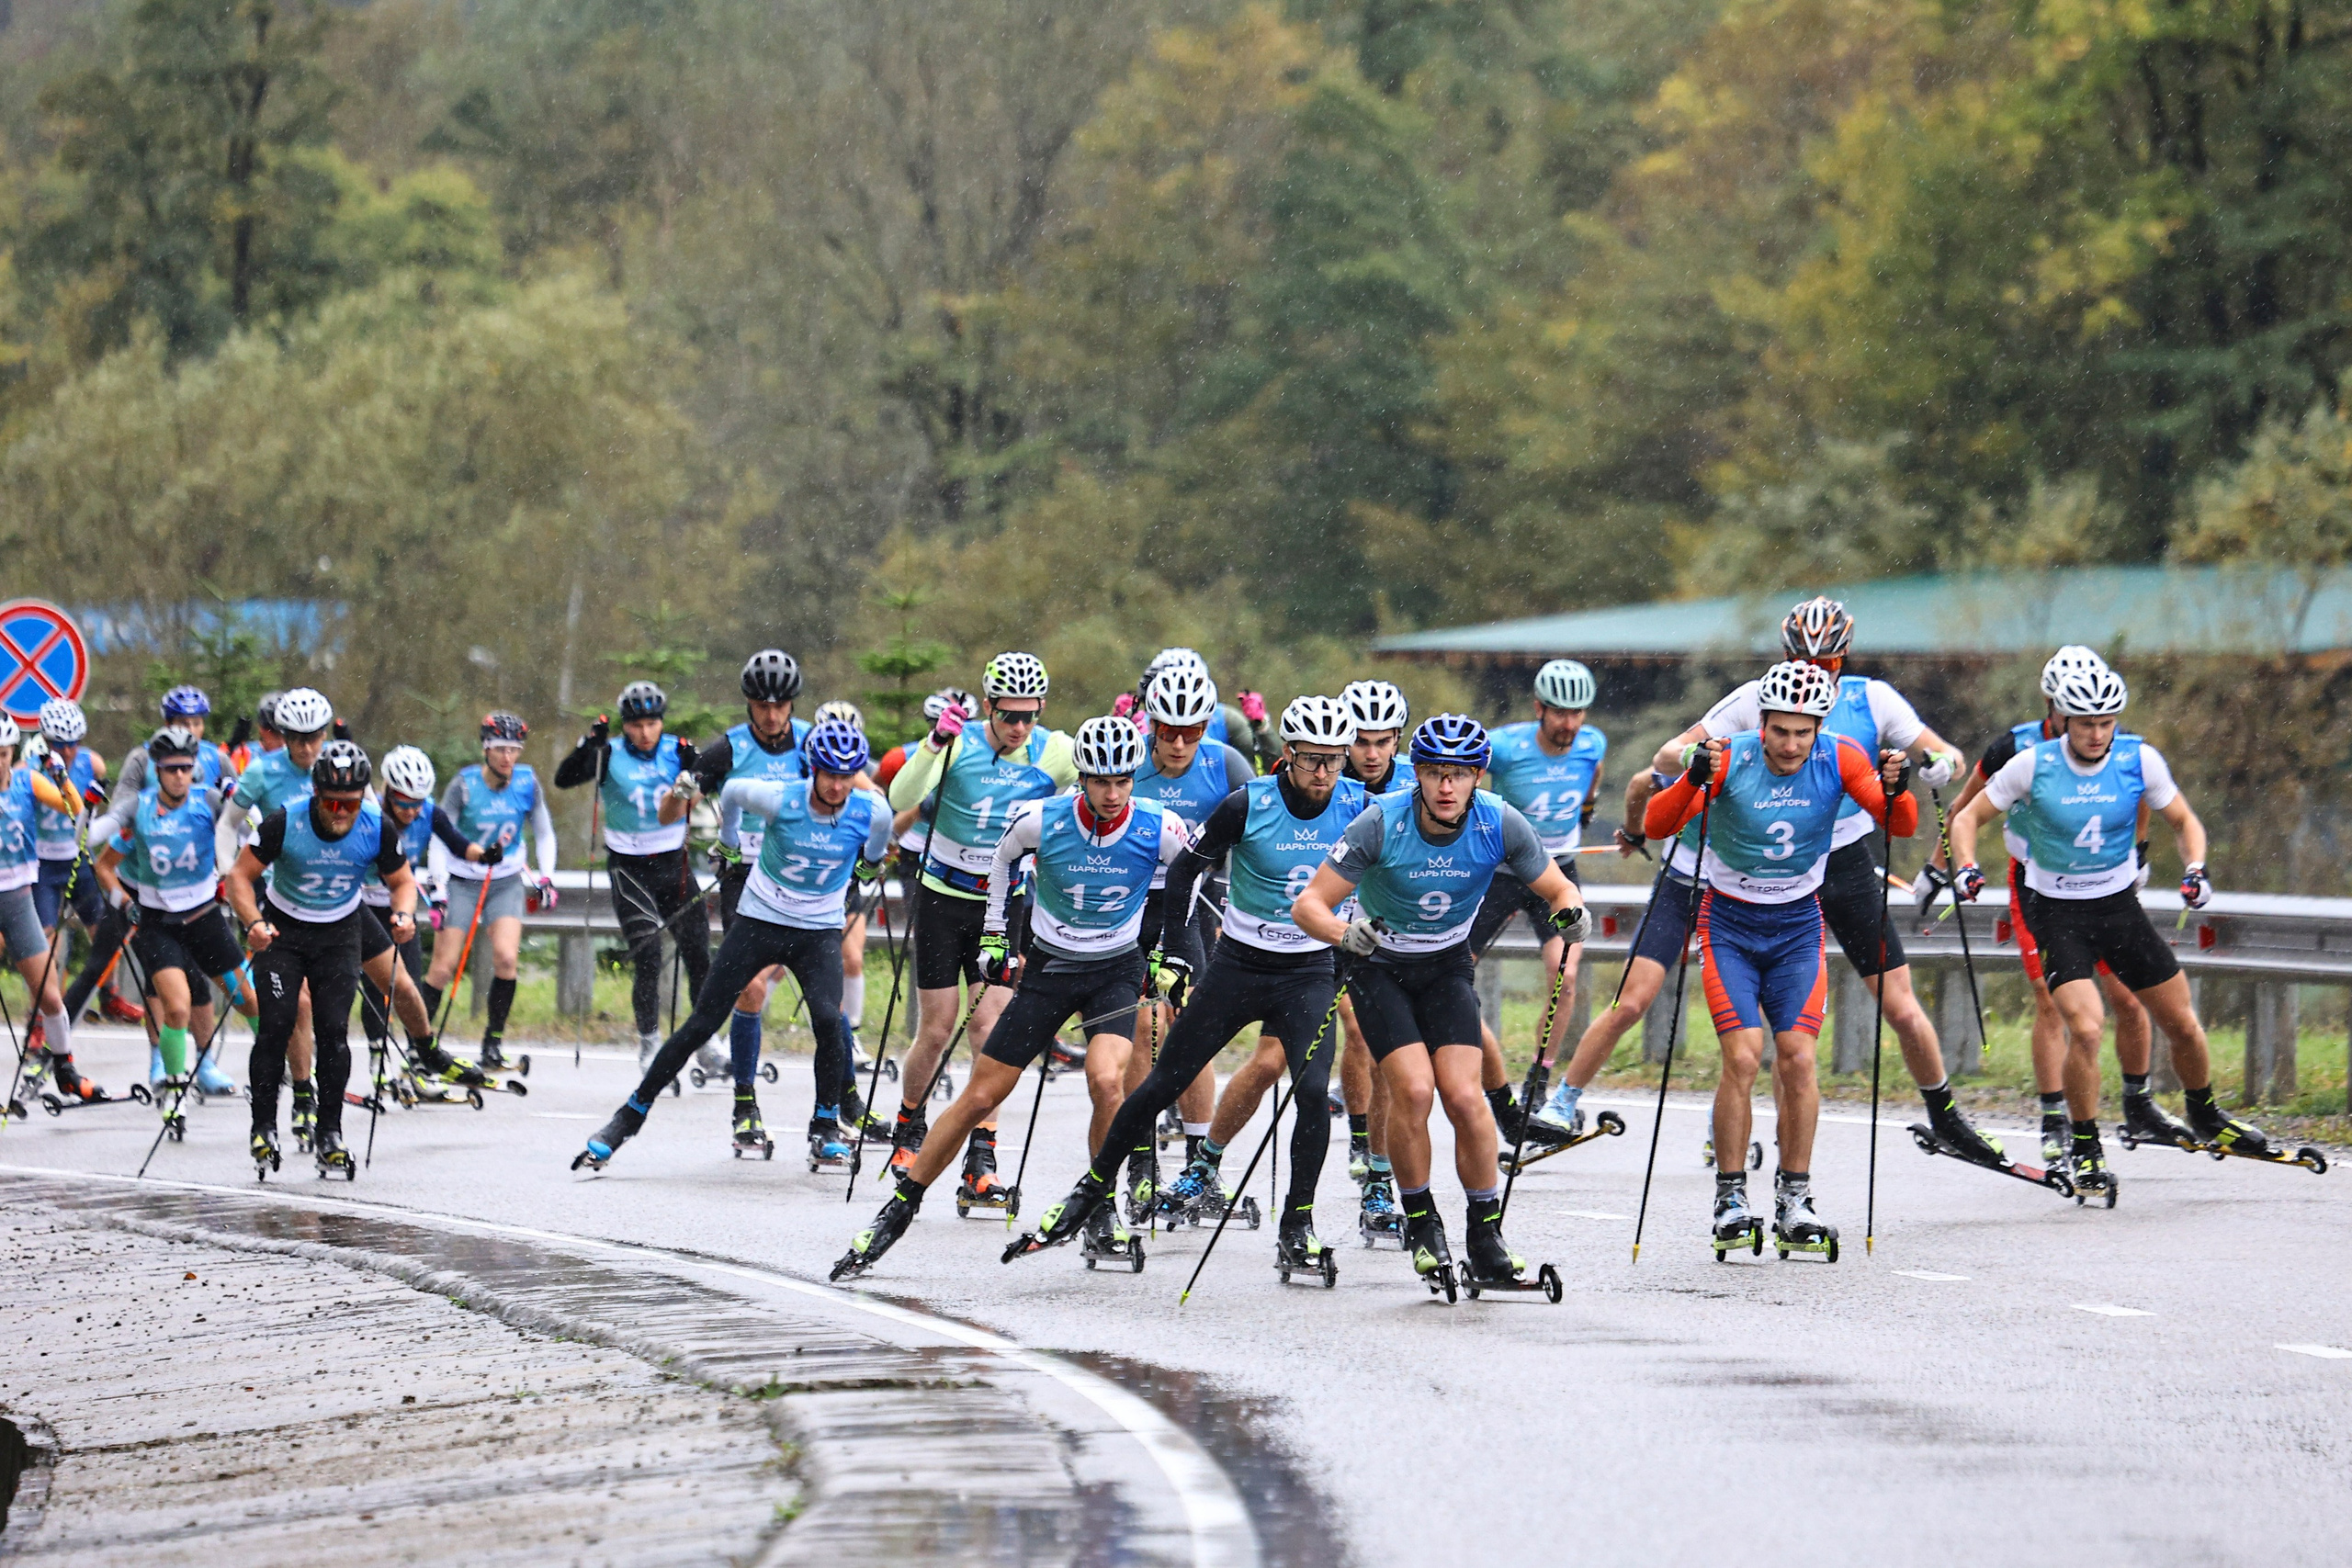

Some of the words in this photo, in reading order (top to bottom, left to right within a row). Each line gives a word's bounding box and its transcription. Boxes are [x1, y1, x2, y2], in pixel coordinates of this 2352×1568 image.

[1171, 799, 1198, 807] ГОРЫ
[1521, 790, 1582, 822] 42
[1754, 800, 1782, 809] ЦАРЬ
[1782, 799, 1812, 808] ГОРЫ
[2061, 796, 2088, 805] ЦАРЬ
[2088, 795, 2117, 804] ГОРЫ
[1275, 842, 1306, 852] ЦАРЬ
[1306, 842, 1334, 851] ГОРЫ
[1762, 820, 1796, 862] 3
[2074, 815, 2105, 855] 4
[150, 841, 198, 876] 64
[780, 854, 843, 886] 27
[1069, 864, 1098, 874] ЦАРЬ
[1099, 866, 1128, 874] ГОРЫ
[298, 873, 355, 897] 25
[1284, 864, 1317, 902] 8
[1409, 870, 1439, 879] ЦАРЬ
[1440, 870, 1471, 878] ГОРЫ
[1063, 884, 1131, 913] 12
[1418, 890, 1453, 921] 9
[1267, 930, 1310, 941] СТОРИ
